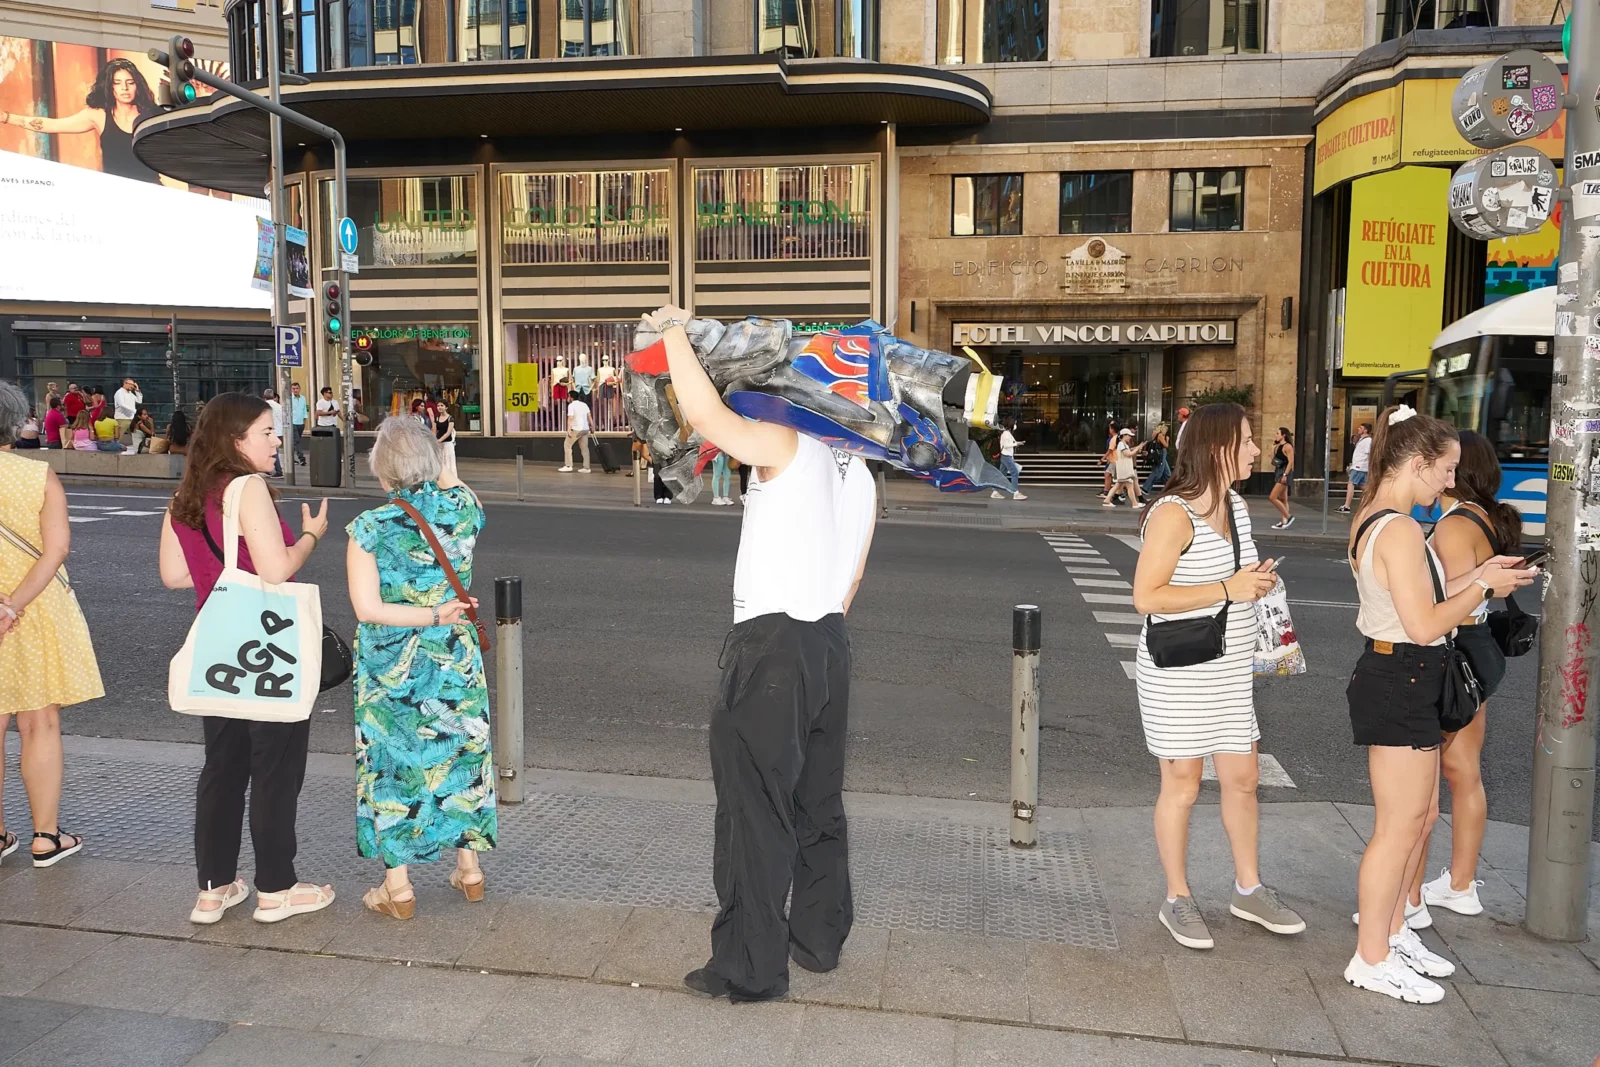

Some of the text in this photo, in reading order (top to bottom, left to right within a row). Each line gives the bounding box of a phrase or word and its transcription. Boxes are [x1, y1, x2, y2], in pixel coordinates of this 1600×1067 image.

[1347, 115, 1396, 147] CULTURA
[374, 209, 475, 233] UNITED
[506, 205, 618, 231] COLORS
[626, 204, 665, 229] OF
[1361, 217, 1436, 246] REFÚGIATE
[1384, 244, 1411, 261] EN LA
[952, 260, 1048, 276] EDIFICIO
[1143, 257, 1244, 273] CARRION
[1361, 260, 1431, 288] CULTURA
[279, 327, 300, 354] P
[365, 328, 403, 339] COLORS
[405, 328, 419, 339] OF
[953, 323, 1234, 343] HOTEL VINCCI CAPITOL
